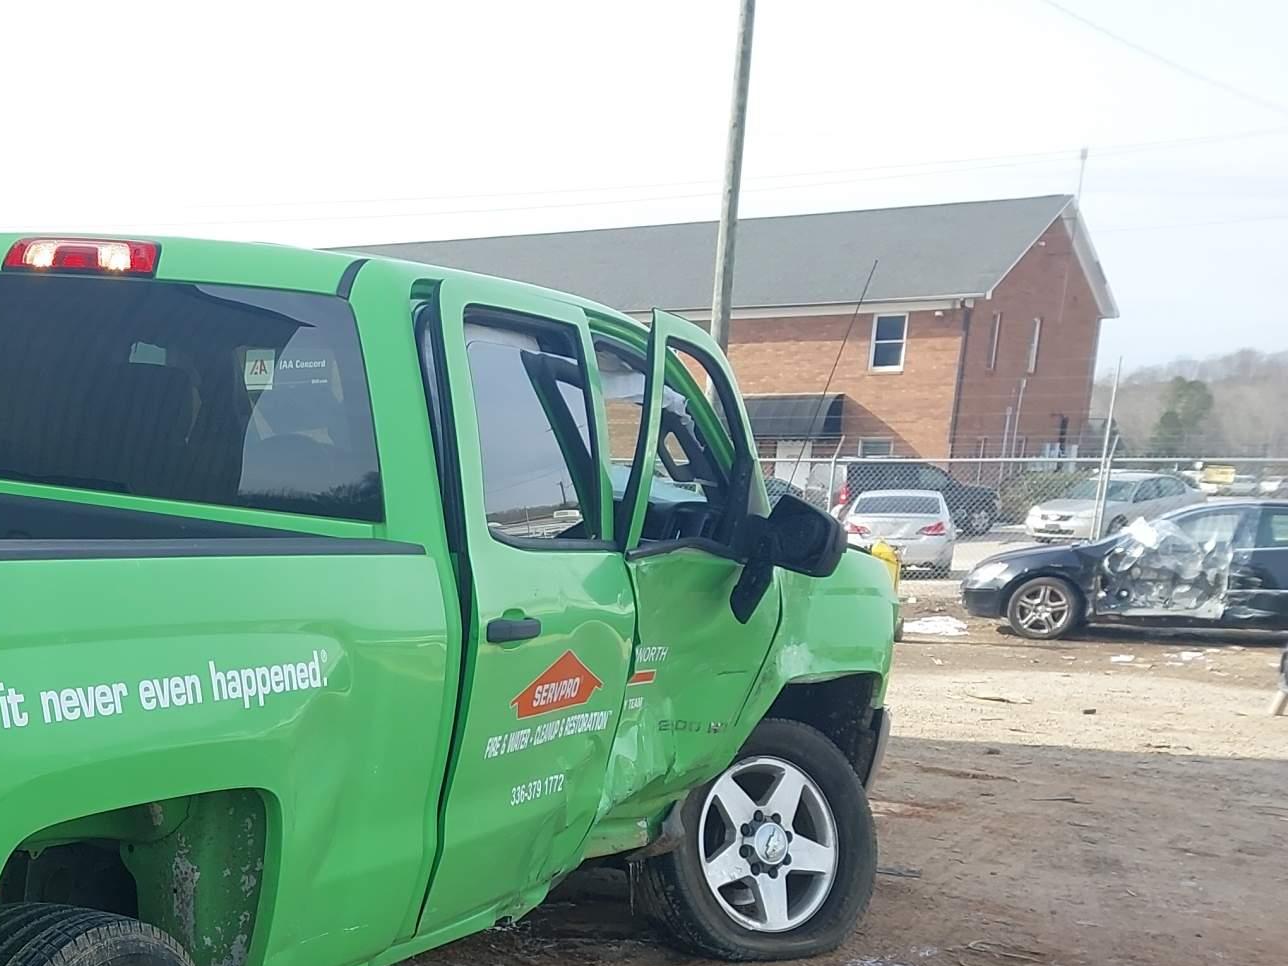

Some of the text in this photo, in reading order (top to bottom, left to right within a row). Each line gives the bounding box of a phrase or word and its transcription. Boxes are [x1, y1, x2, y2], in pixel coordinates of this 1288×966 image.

[40, 681, 129, 724] never
[139, 674, 203, 711] even
[484, 735, 502, 760] FIRE
[507, 728, 532, 753] WATER
[533, 720, 561, 746] CLEANUP
[510, 774, 565, 806] 336-379 1772
